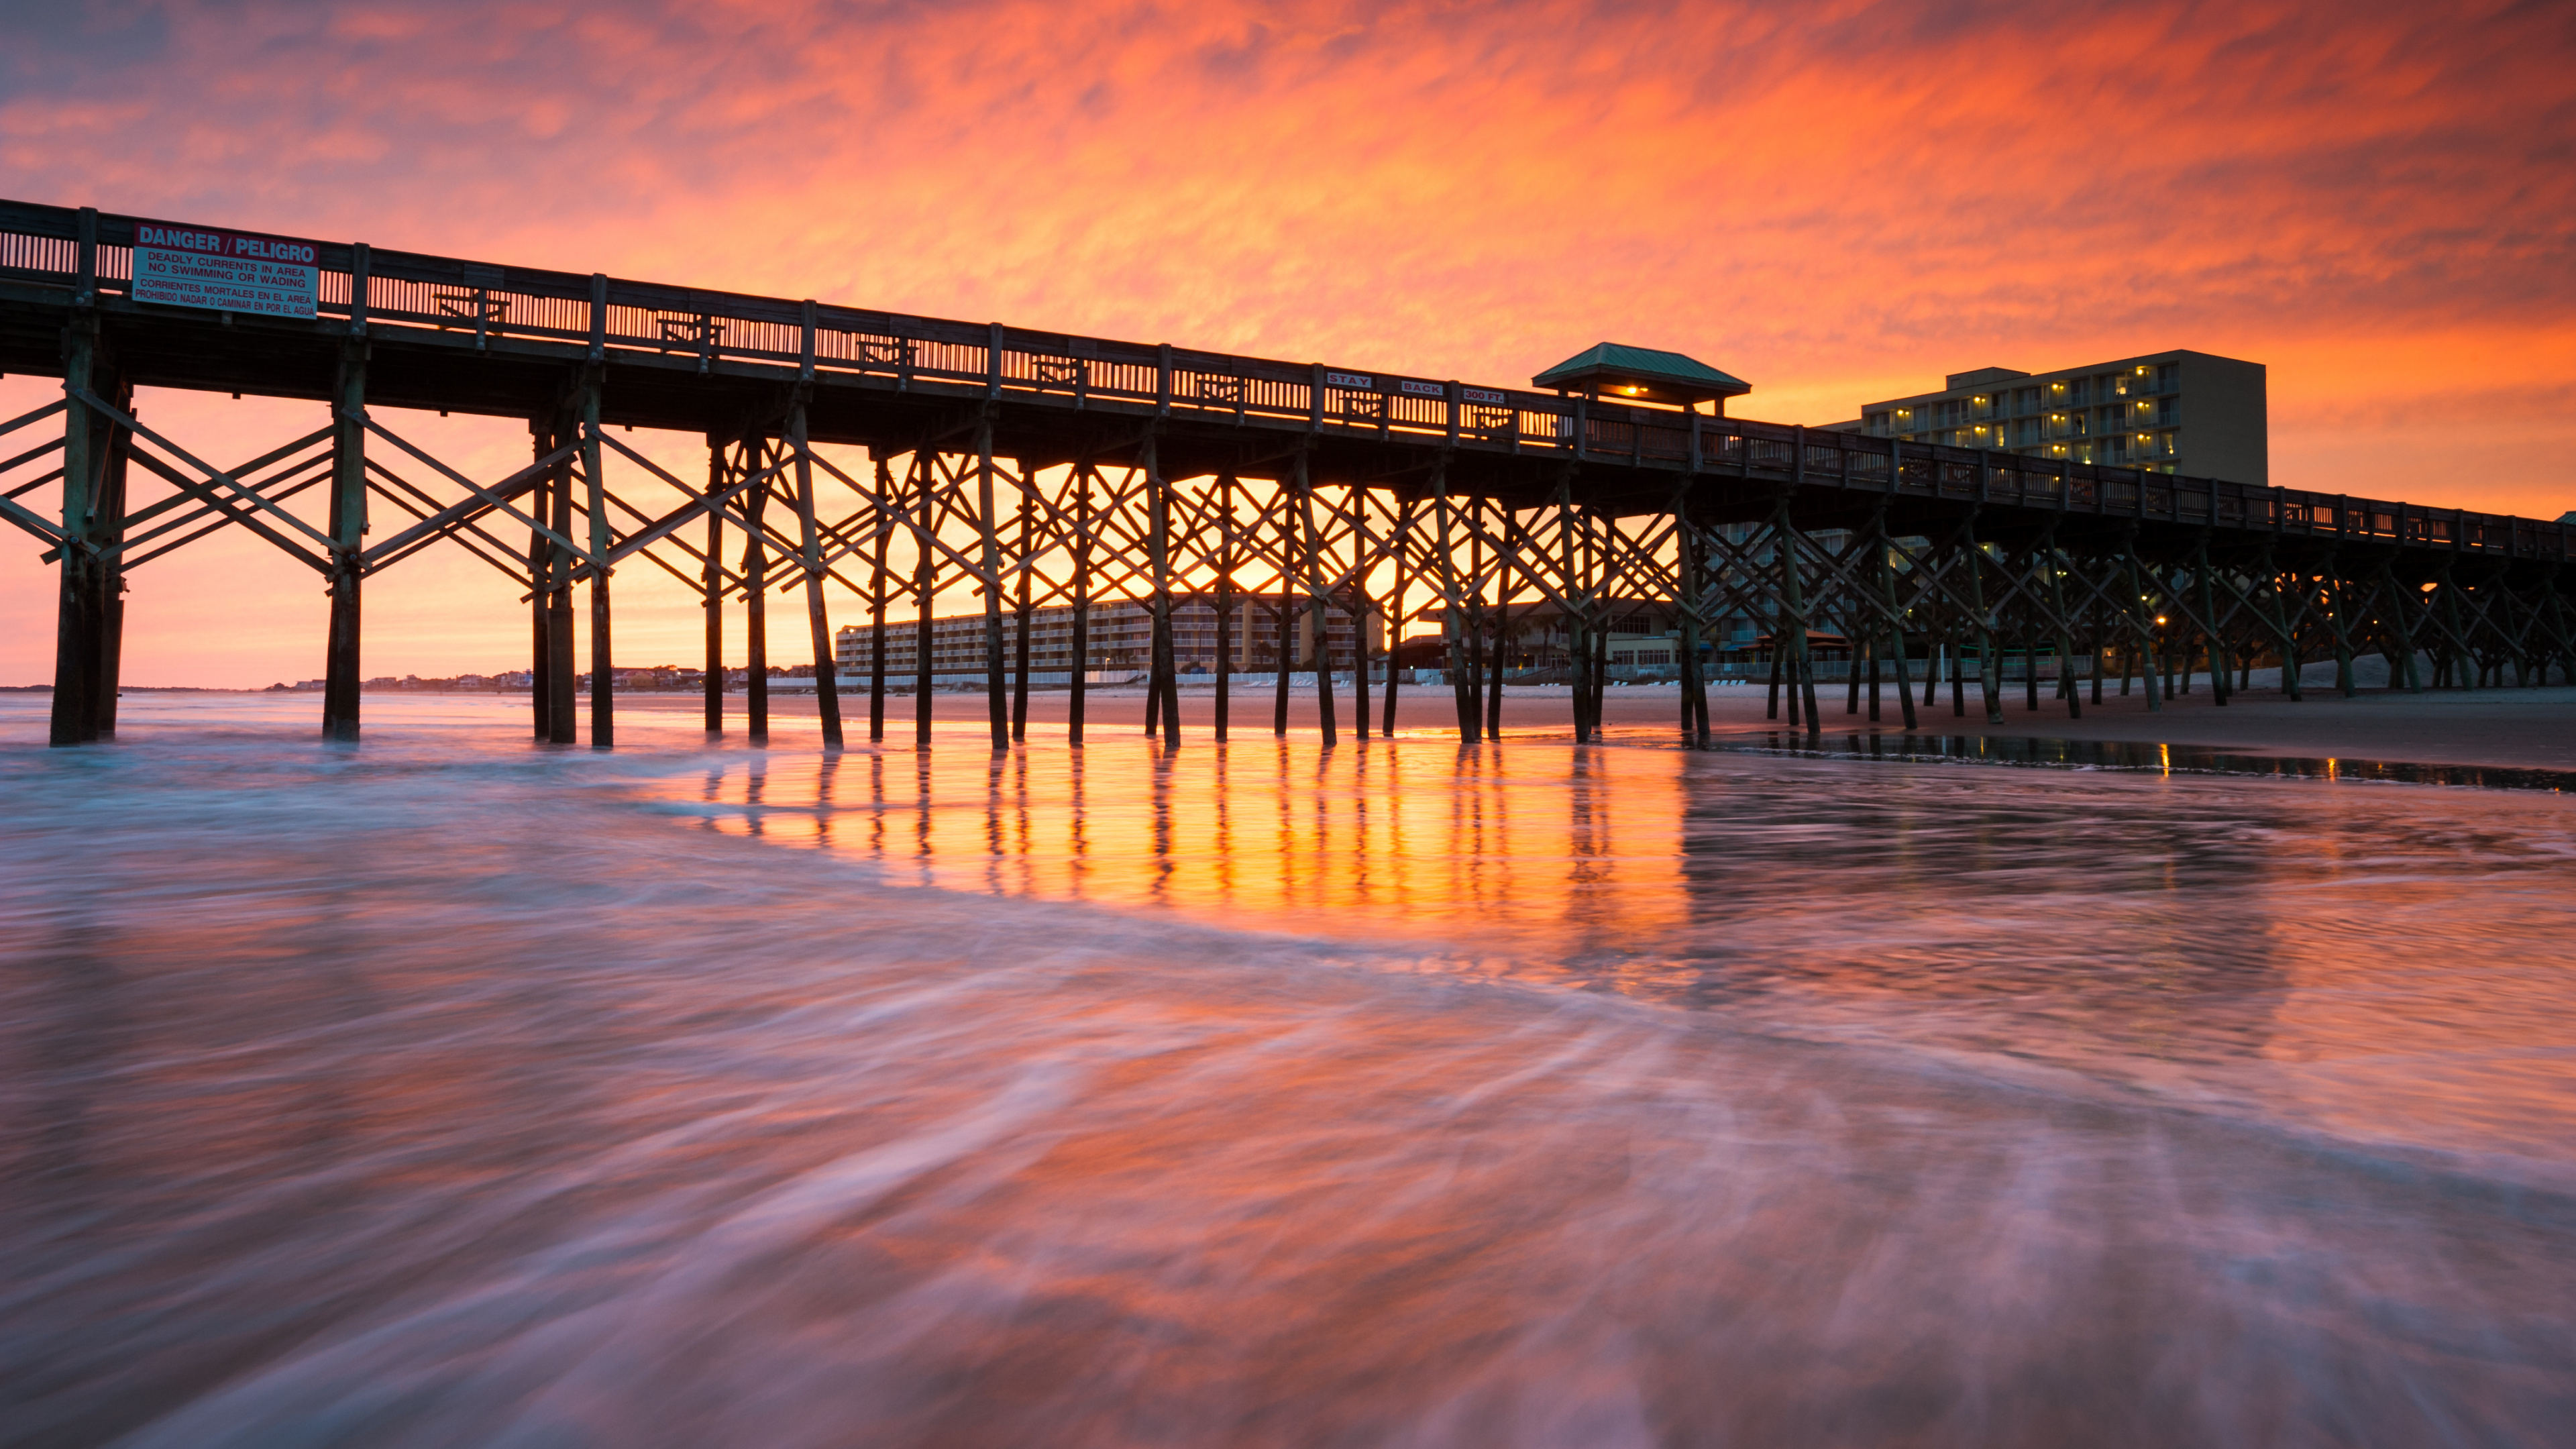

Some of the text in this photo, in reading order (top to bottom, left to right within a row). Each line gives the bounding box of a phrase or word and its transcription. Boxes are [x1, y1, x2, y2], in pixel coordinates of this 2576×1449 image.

[140, 226, 220, 252] DANGER
[236, 238, 314, 262] PELIGRO
[148, 252, 306, 278] DEADLY CURRENTS IN AREA
[148, 262, 306, 288] NO SWIMMING OR WADING
[135, 288, 178, 302] PROHIBIDO
[180, 294, 207, 305] NADAR
[209, 297, 215, 306] O
[217, 298, 252, 309] CAMINAR
[254, 301, 263, 311] EN
[266, 303, 280, 313] POR
[283, 305, 292, 314] EL
[140, 278, 201, 292] CORRIENTES
[204, 286, 255, 299] MORTALES
[258, 291, 270, 300] EN
[273, 292, 284, 302] EL
[1329, 374, 1503, 402] STAY BACK 300 FT.
